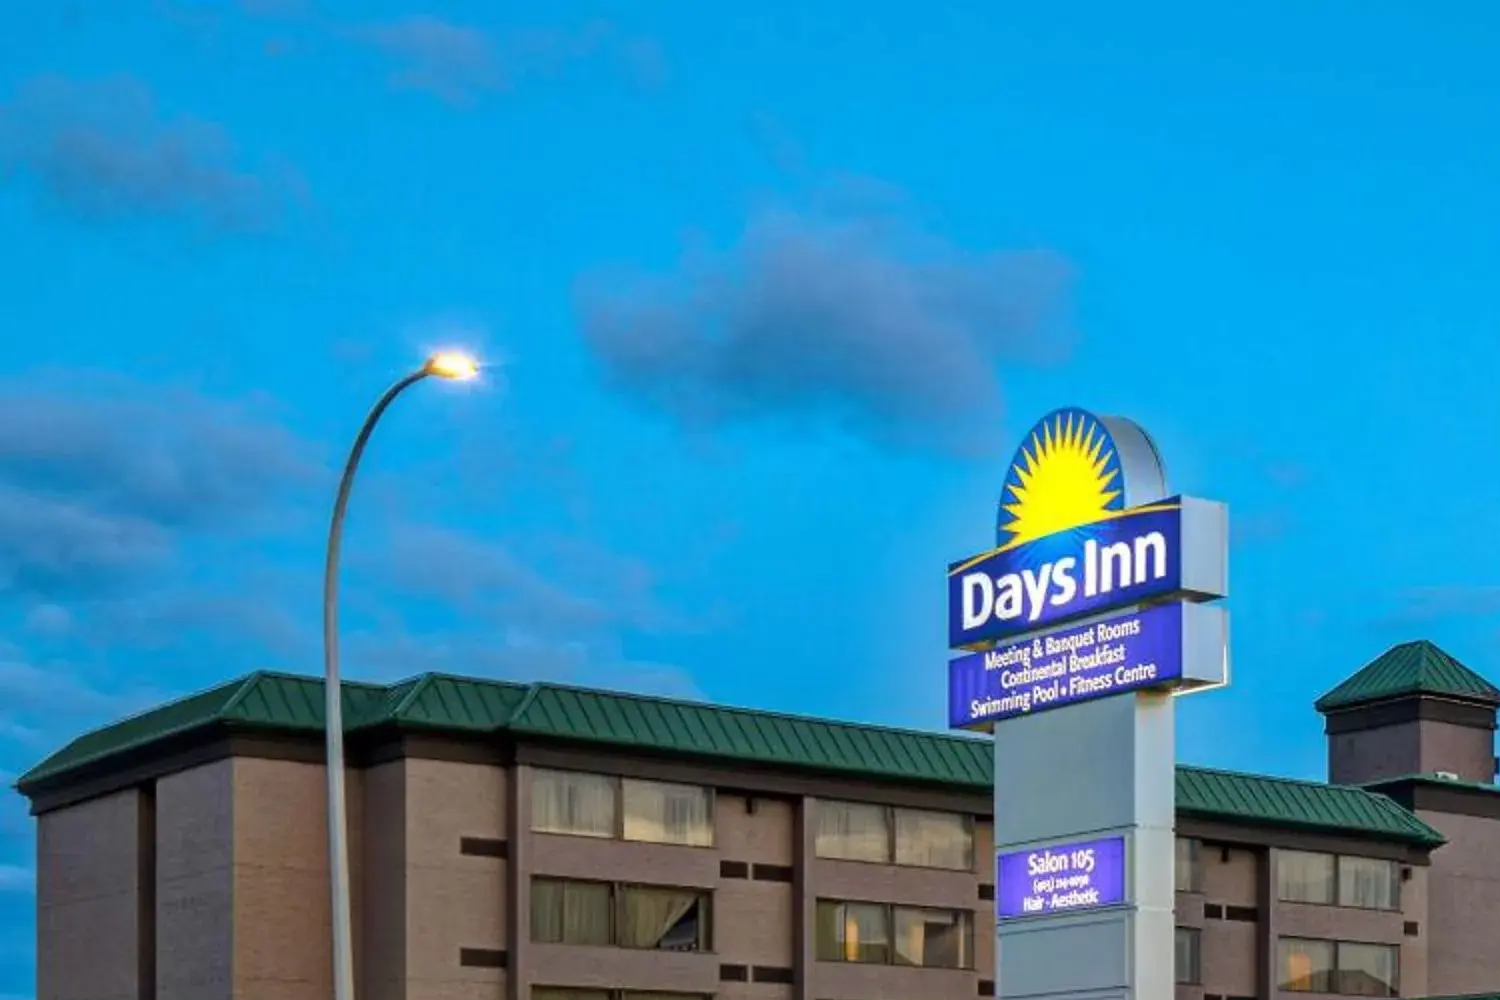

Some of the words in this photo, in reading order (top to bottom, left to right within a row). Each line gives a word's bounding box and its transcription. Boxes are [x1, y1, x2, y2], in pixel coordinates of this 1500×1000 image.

[962, 556, 1076, 630] Days
[1084, 531, 1167, 597] Inn
[985, 646, 1030, 671] Meeting
[1032, 640, 1043, 658] &
[1045, 628, 1095, 656] Banquet
[1097, 619, 1140, 643] Rooms
[1001, 656, 1066, 688] Continental
[1069, 644, 1126, 673] Breakfast
[971, 690, 1031, 719] Swimming
[1033, 680, 1059, 704] Pool
[1069, 673, 1112, 697] Fitness
[1115, 664, 1157, 685] Centre
[1027, 851, 1069, 876] Salon
[1072, 848, 1096, 873] 105
[1023, 895, 1045, 912] Hair
